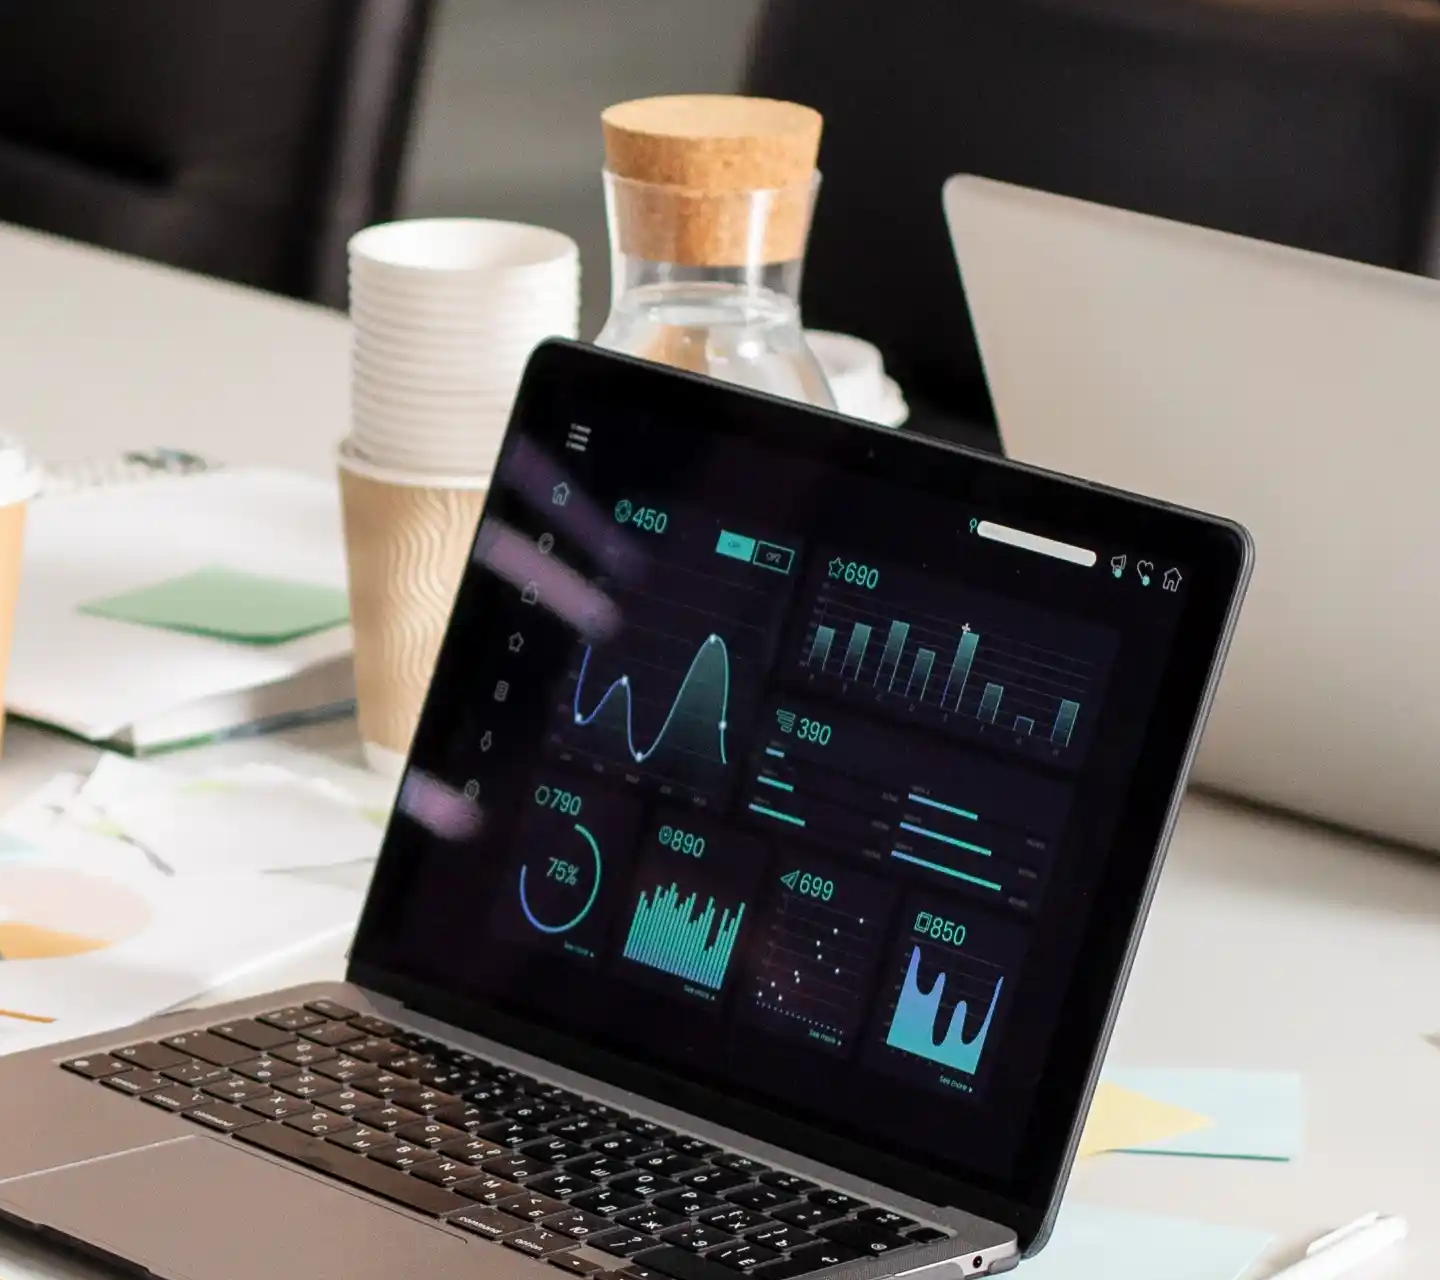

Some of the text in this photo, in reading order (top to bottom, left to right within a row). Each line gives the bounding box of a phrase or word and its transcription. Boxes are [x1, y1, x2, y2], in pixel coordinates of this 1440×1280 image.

[632, 508, 668, 533] 450
[844, 562, 879, 589] 690
[797, 718, 832, 746] 390
[550, 788, 582, 816] 790
[670, 830, 706, 858] 890
[546, 856, 579, 886] 75%
[798, 872, 834, 902] 699
[930, 917, 966, 946] 850
[939, 1074, 968, 1091] See more
[194, 1110, 234, 1126] command
[518, 1108, 532, 1116] 6
[549, 1141, 566, 1149] U
[439, 1163, 456, 1171] N
[459, 1216, 503, 1234] command
[514, 1238, 544, 1251] option
